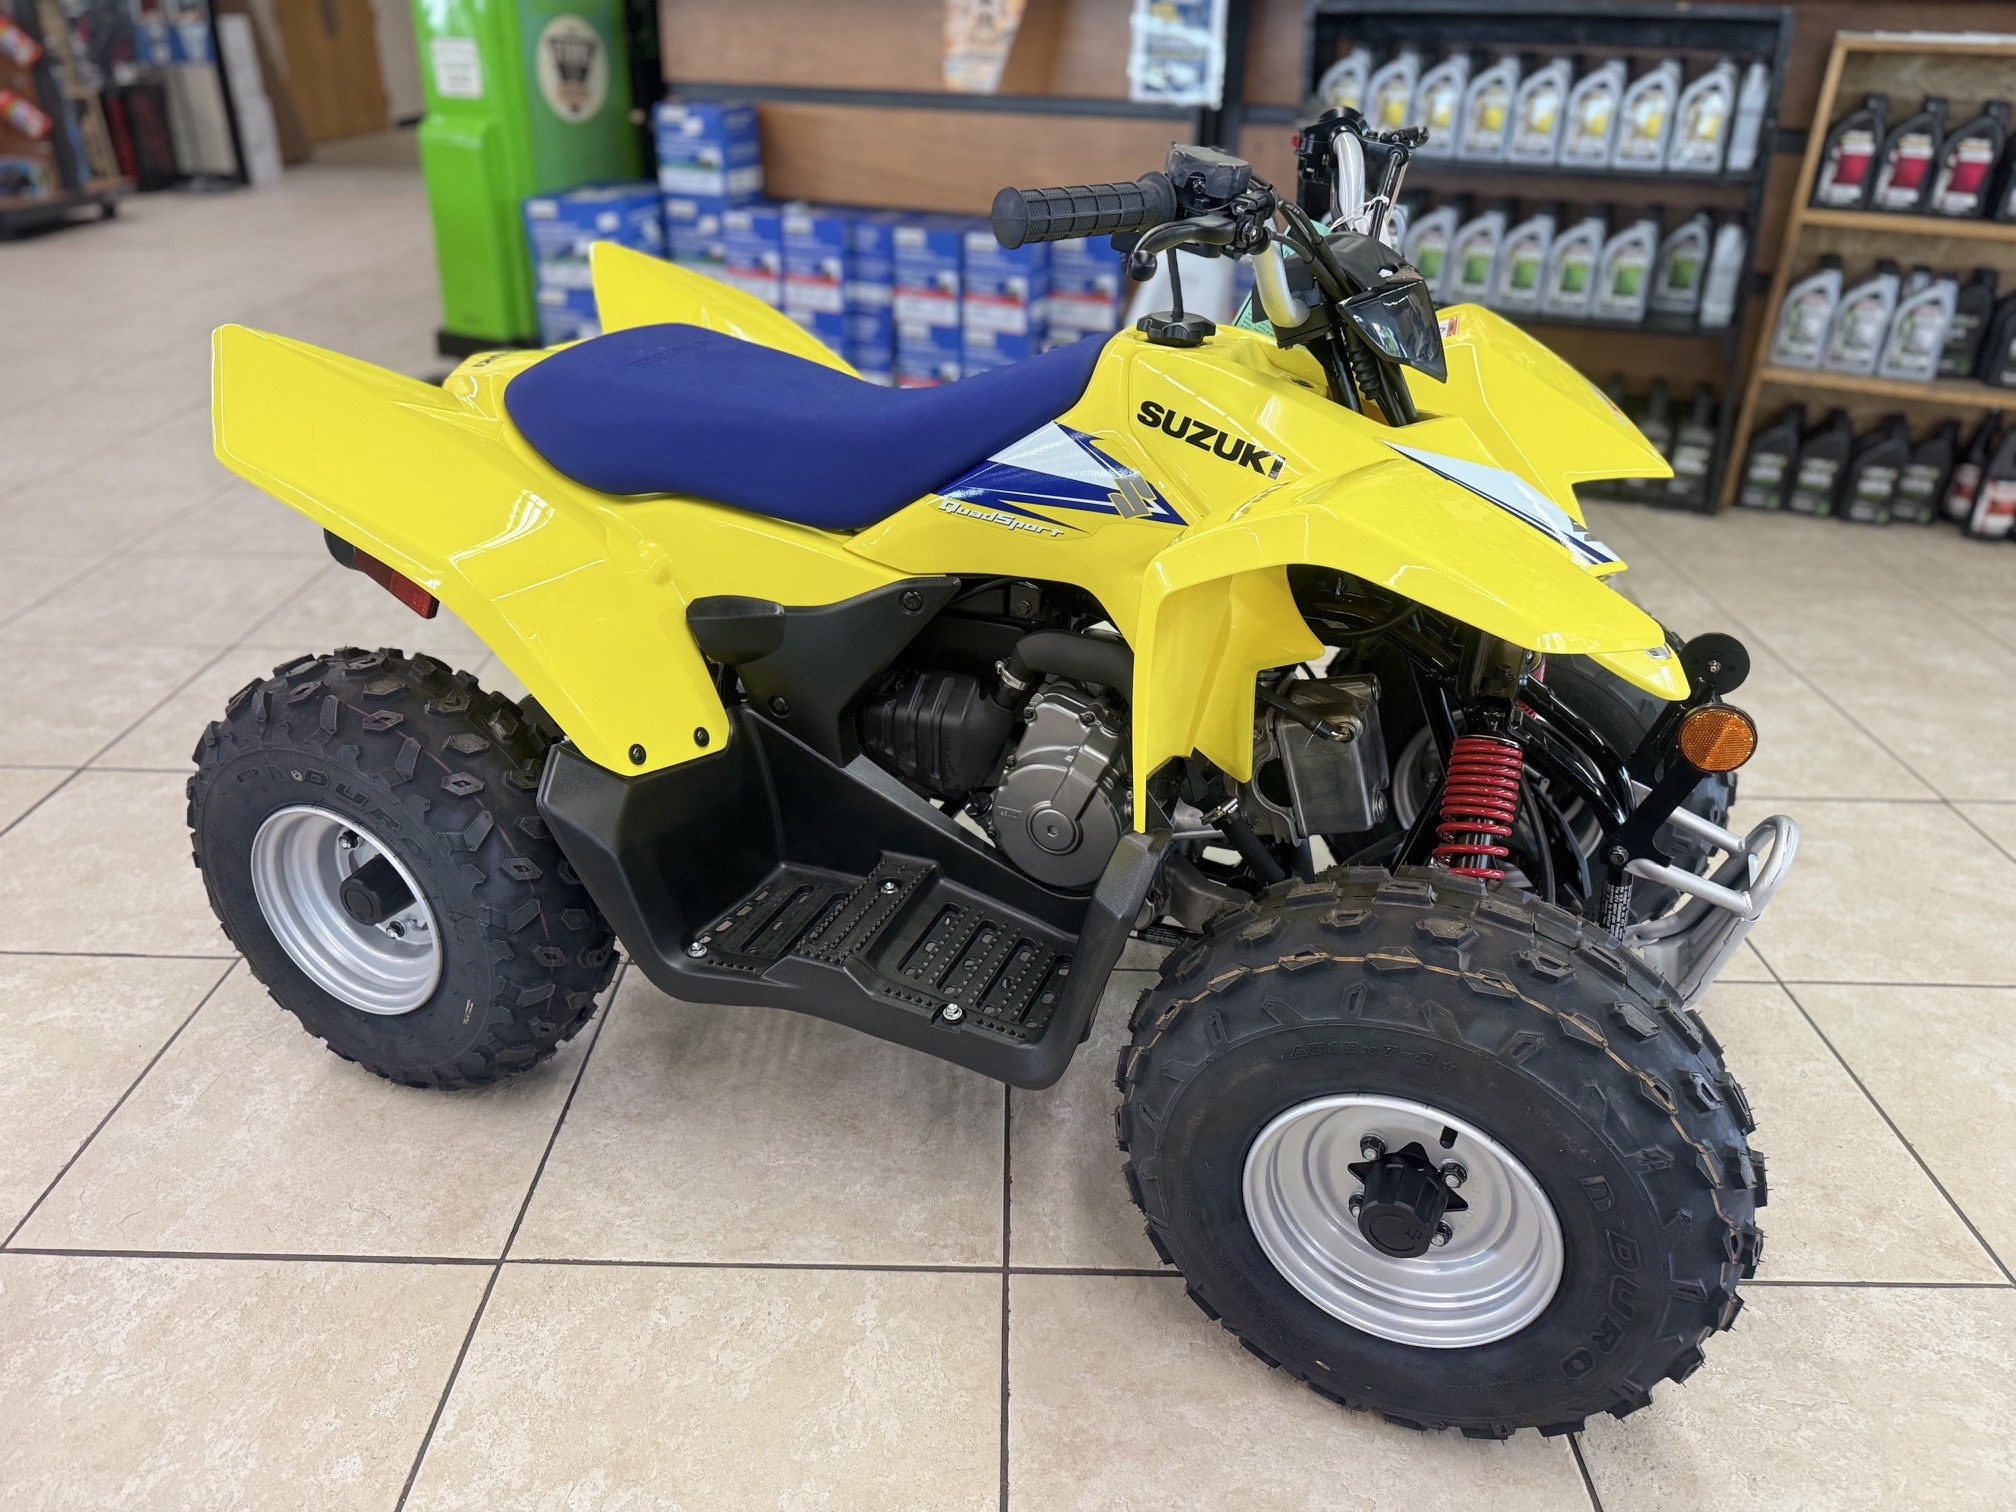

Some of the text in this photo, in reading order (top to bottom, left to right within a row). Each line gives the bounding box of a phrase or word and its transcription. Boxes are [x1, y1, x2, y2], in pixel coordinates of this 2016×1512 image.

[1136, 400, 1287, 481] SUZUKI
[938, 499, 1065, 537] QuadSport
[303, 767, 432, 864] DURO
[1560, 1228, 1643, 1381] DURO
